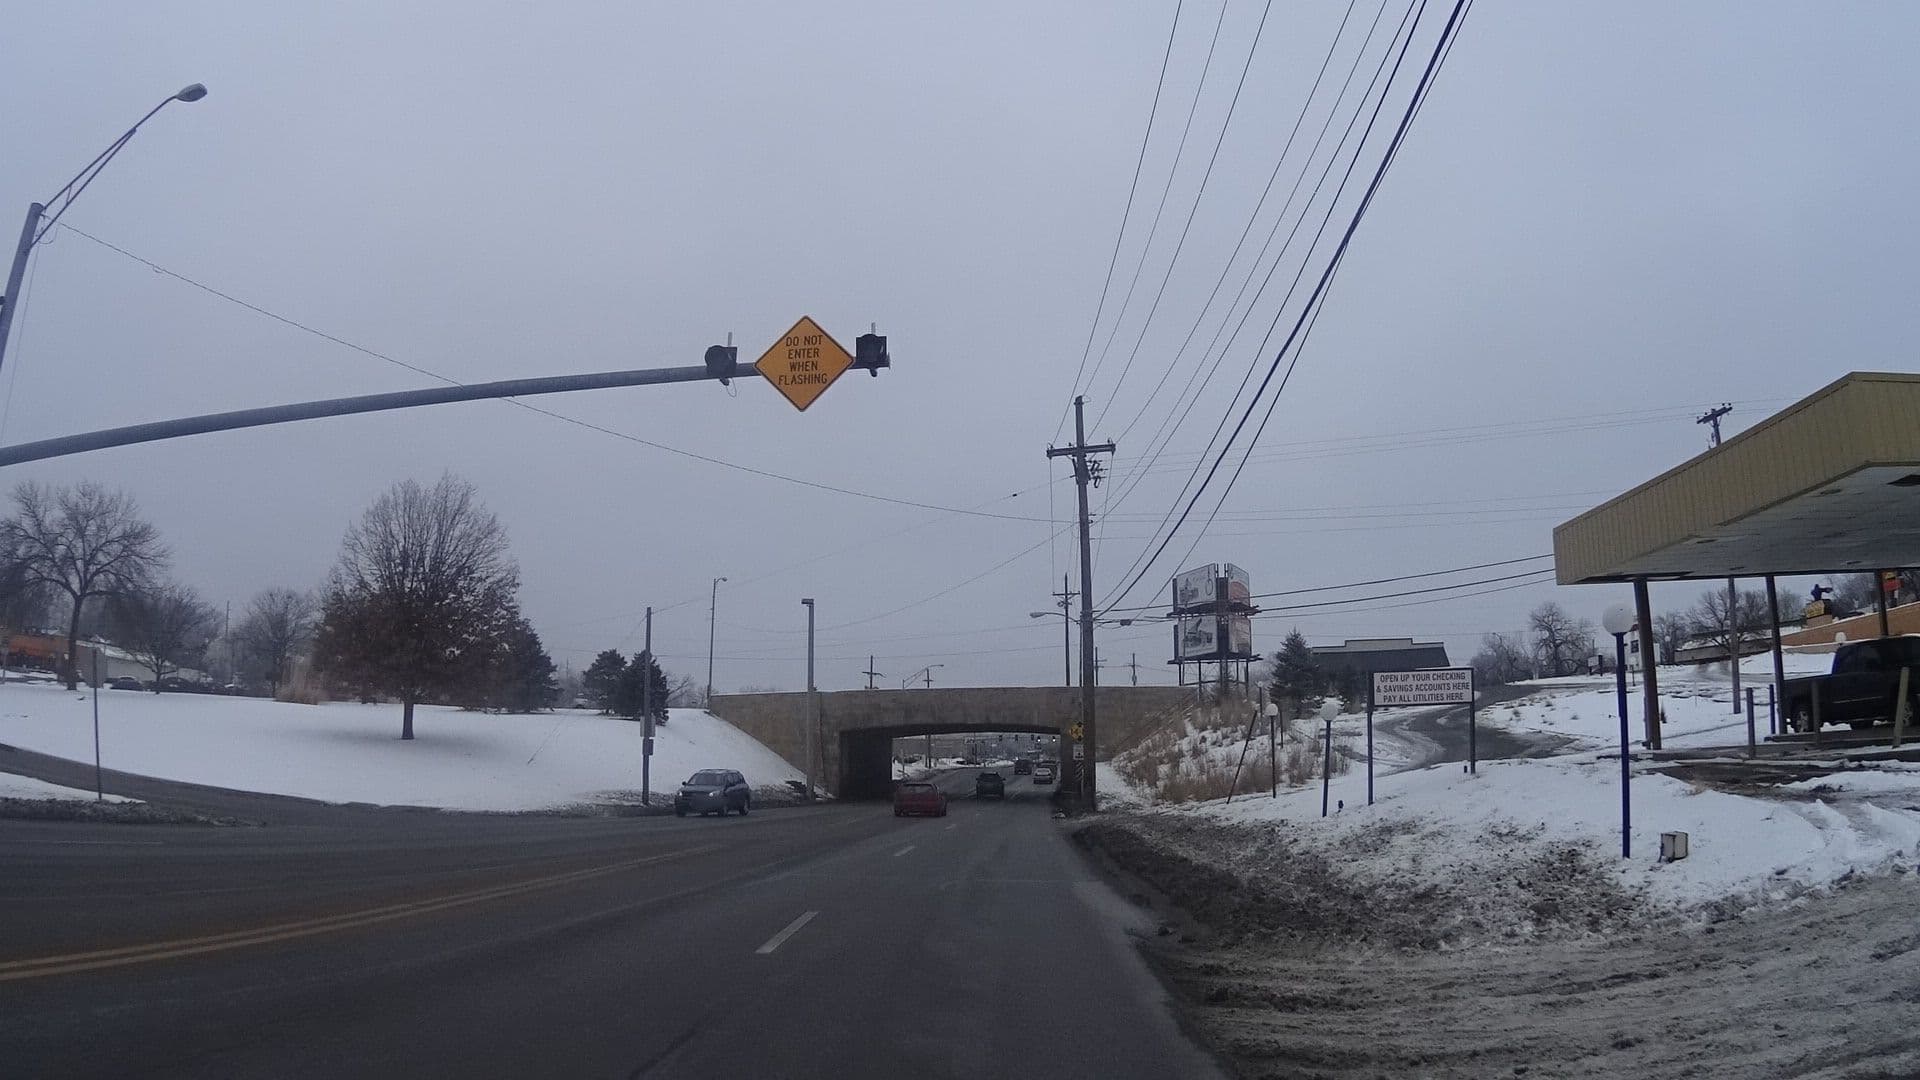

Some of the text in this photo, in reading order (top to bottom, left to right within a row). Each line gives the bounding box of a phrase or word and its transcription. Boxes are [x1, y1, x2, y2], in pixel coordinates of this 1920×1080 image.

[786, 335, 823, 346] DO NOT
[788, 348, 820, 359] ENTER
[789, 361, 818, 372] WHEN
[778, 373, 828, 385] FLASHING
[1380, 674, 1398, 682] OPEN
[1412, 673, 1431, 681] YOUR
[1432, 672, 1465, 680] CHECKING
[1376, 682, 1470, 693] & SAVINGS ACCOUNTS HERE
[1383, 695, 1397, 703] PAY
[1413, 694, 1444, 702] UTILITIES
